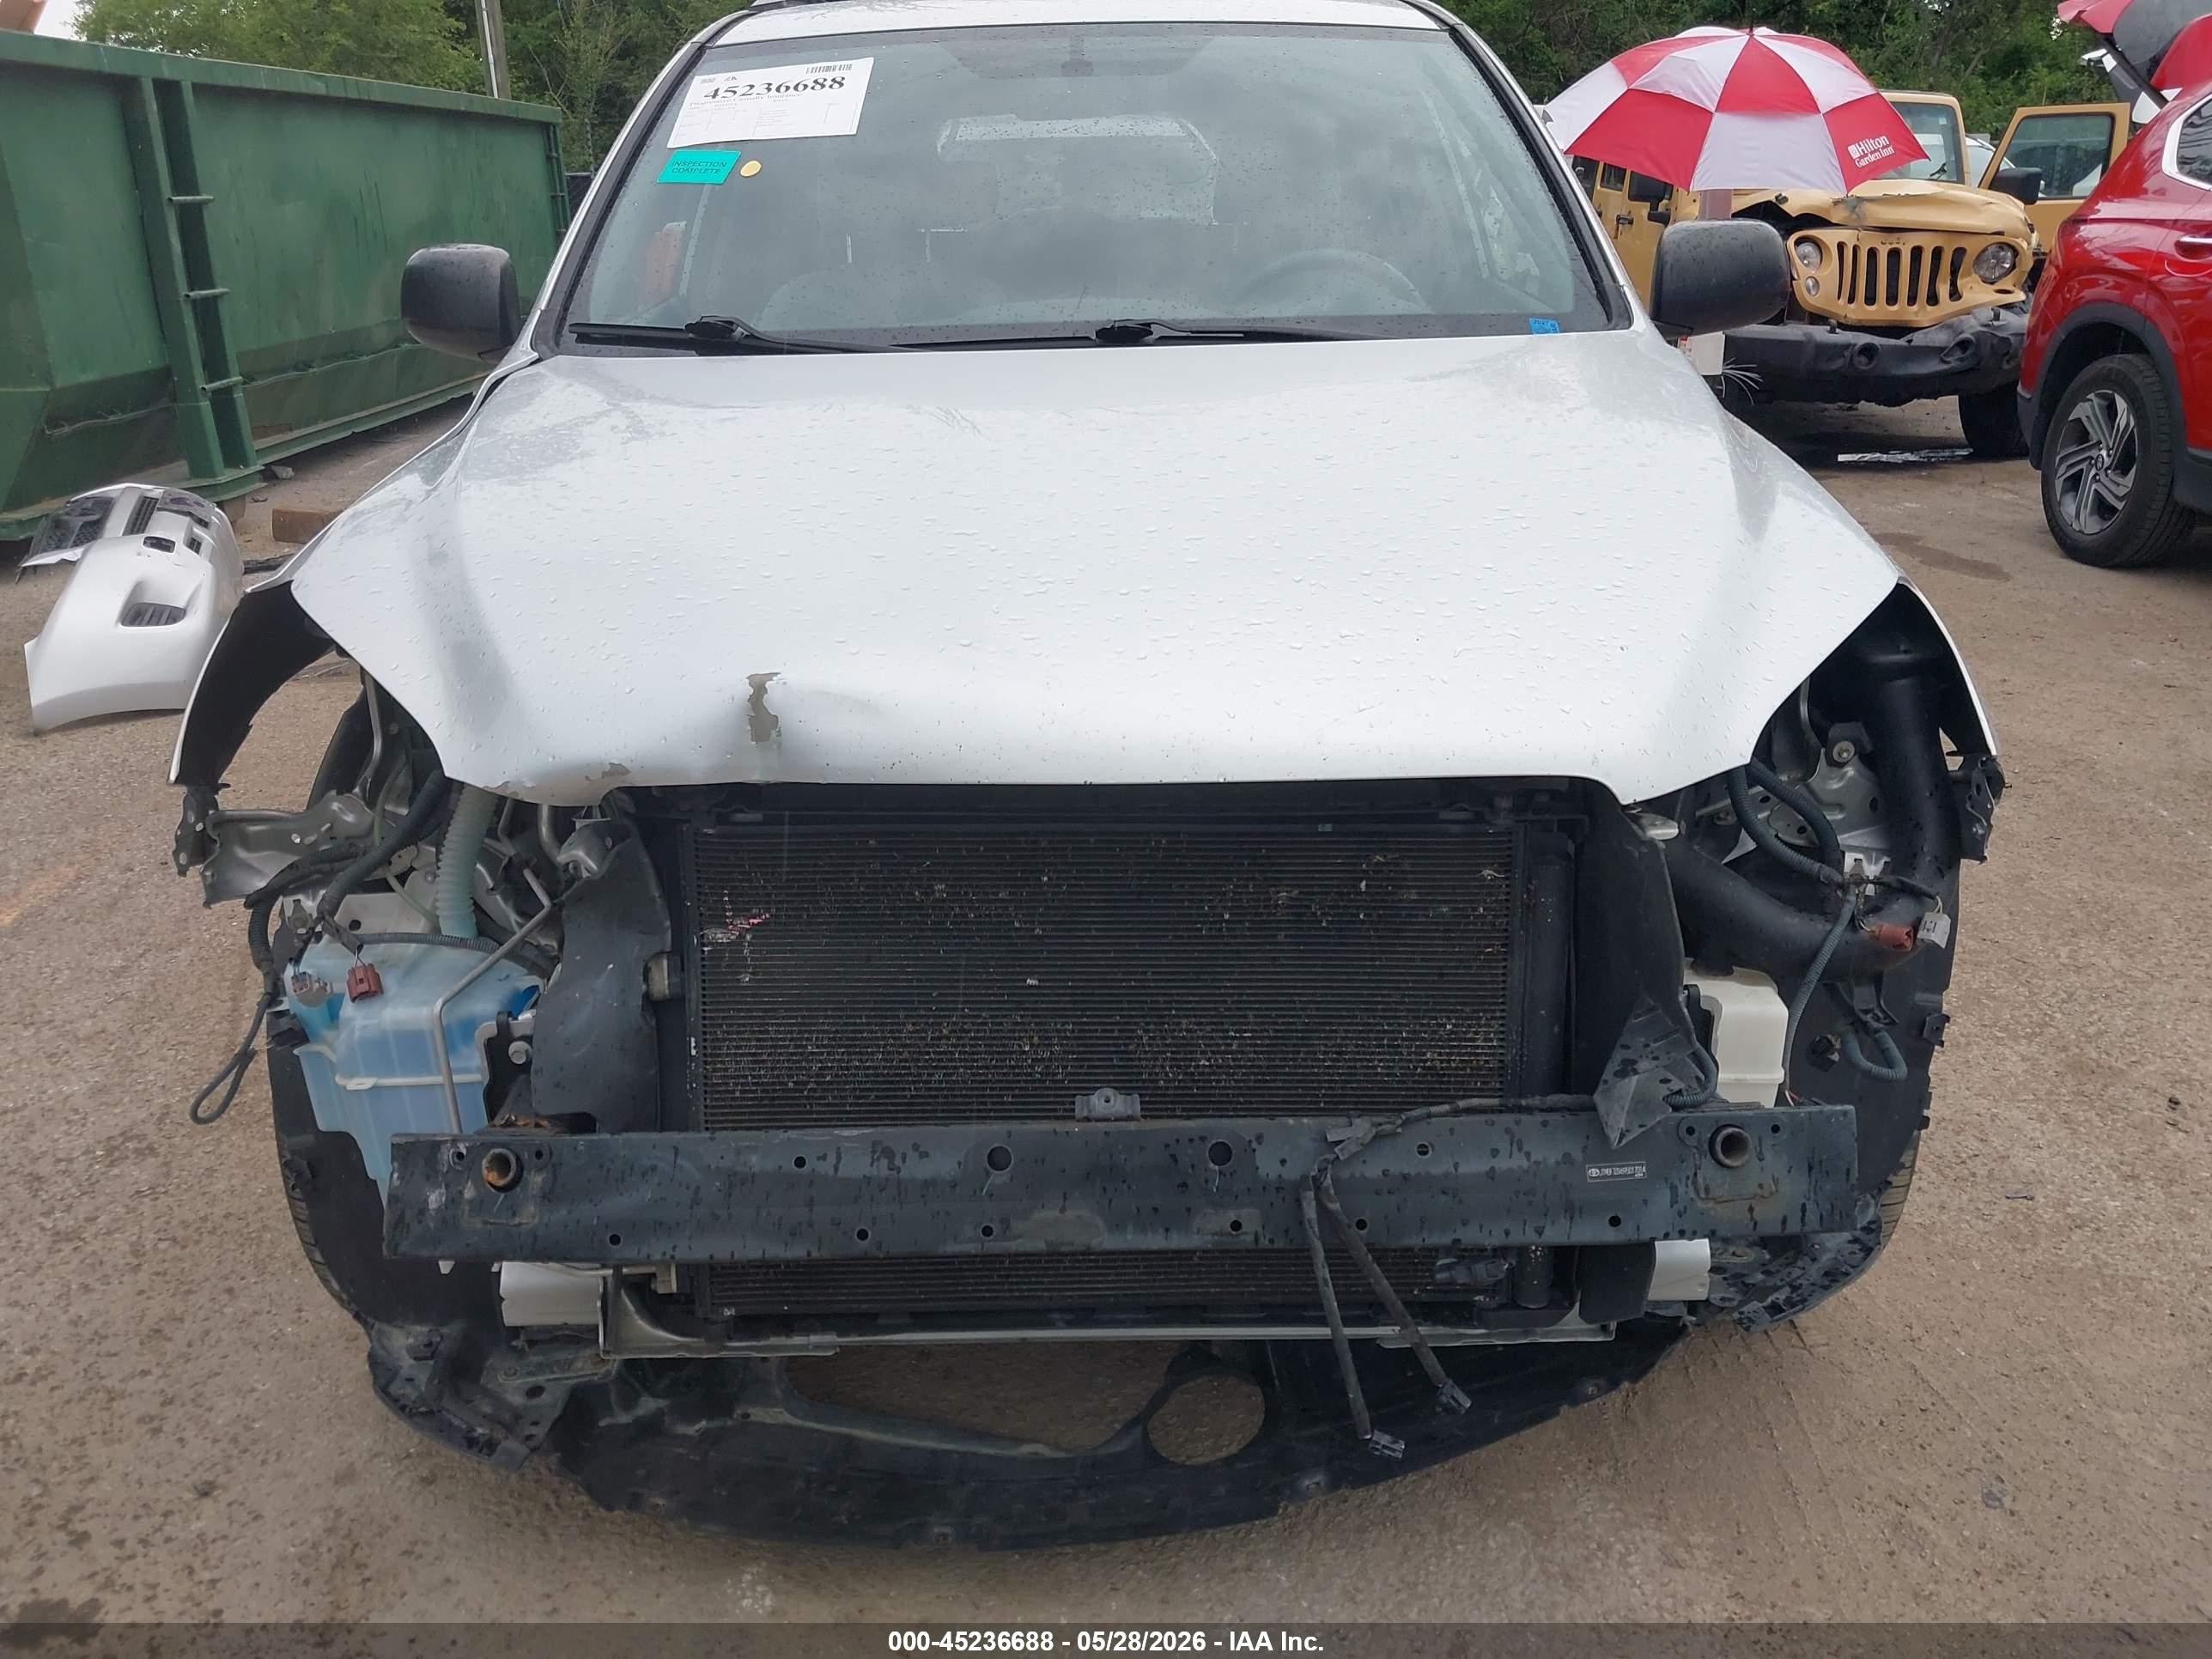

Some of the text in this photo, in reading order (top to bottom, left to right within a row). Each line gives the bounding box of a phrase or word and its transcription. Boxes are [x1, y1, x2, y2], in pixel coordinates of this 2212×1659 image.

[703, 76, 846, 100] 45236688
[1855, 135, 1890, 156] Hilton
[1855, 145, 1895, 168] Garden Inn
